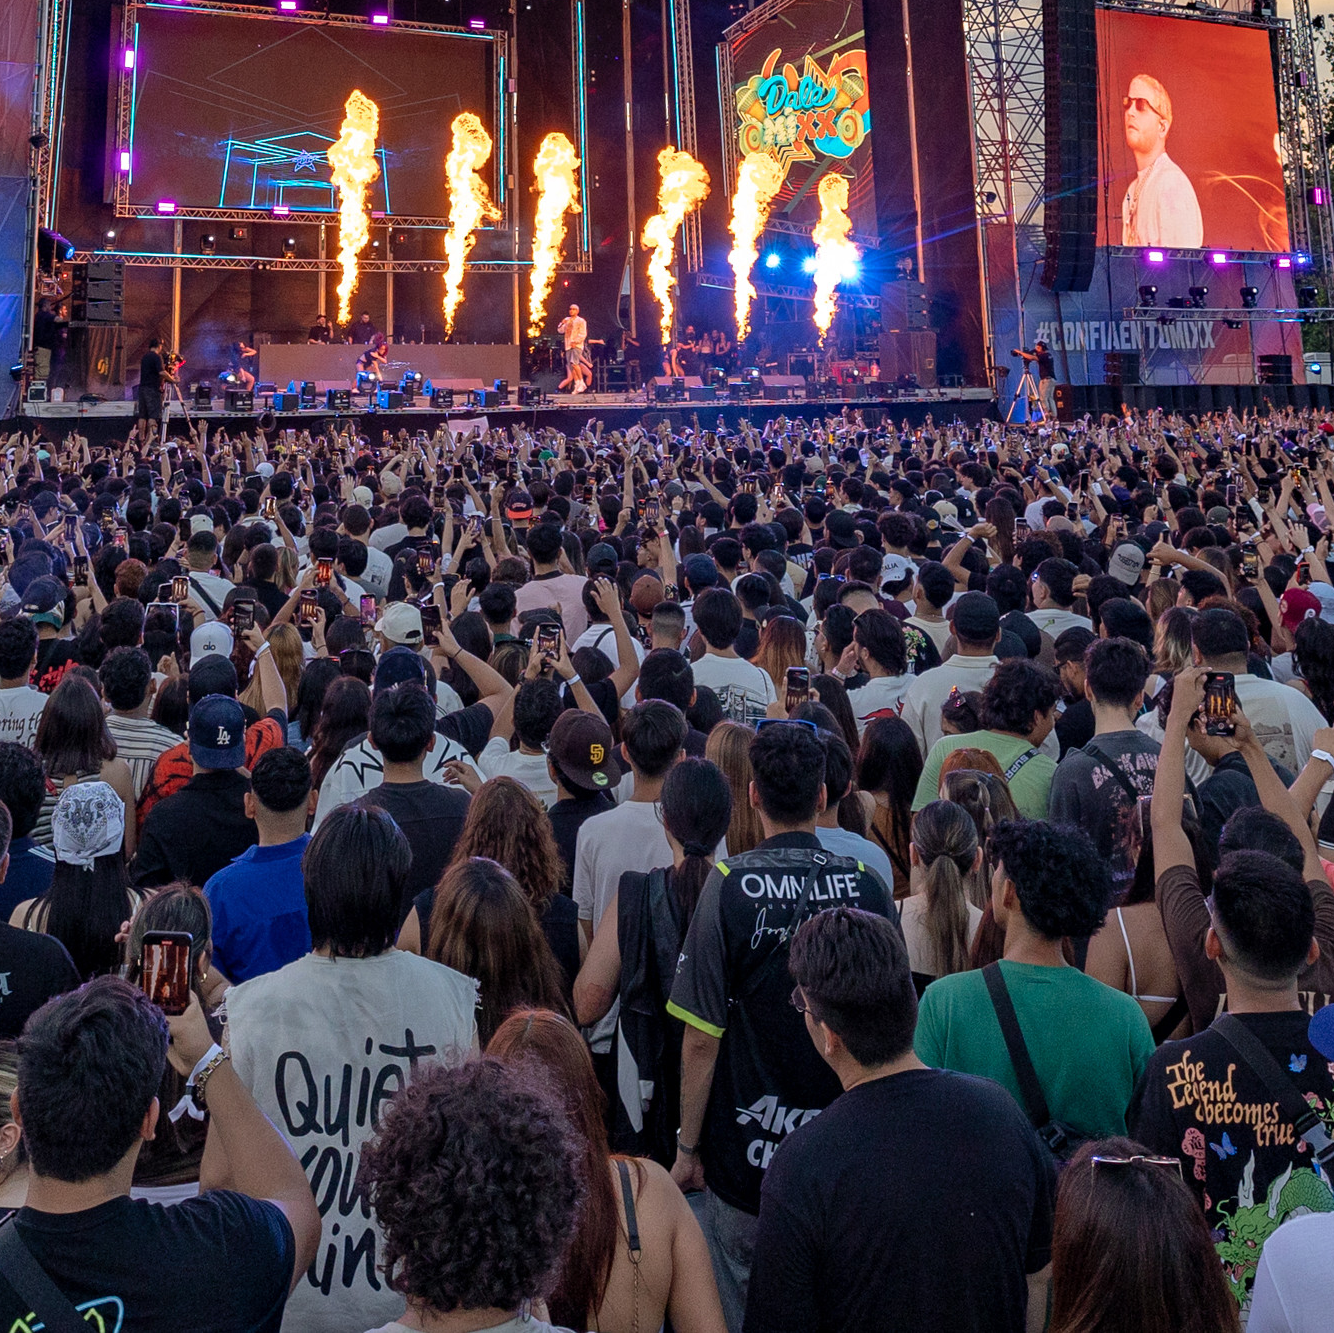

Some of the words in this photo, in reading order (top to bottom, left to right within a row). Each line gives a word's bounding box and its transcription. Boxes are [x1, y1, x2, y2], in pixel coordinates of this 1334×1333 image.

[758, 74, 837, 115] Dale
[203, 641, 216, 650] alo
[216, 726, 231, 745] LA
[1005, 753, 1030, 782] SUPR
[741, 872, 861, 901] OMNLIFE
[1166, 1050, 1205, 1085] The
[1167, 1063, 1238, 1121] Legend
[1202, 1096, 1280, 1125] becomes
[1253, 1123, 1295, 1147] true
